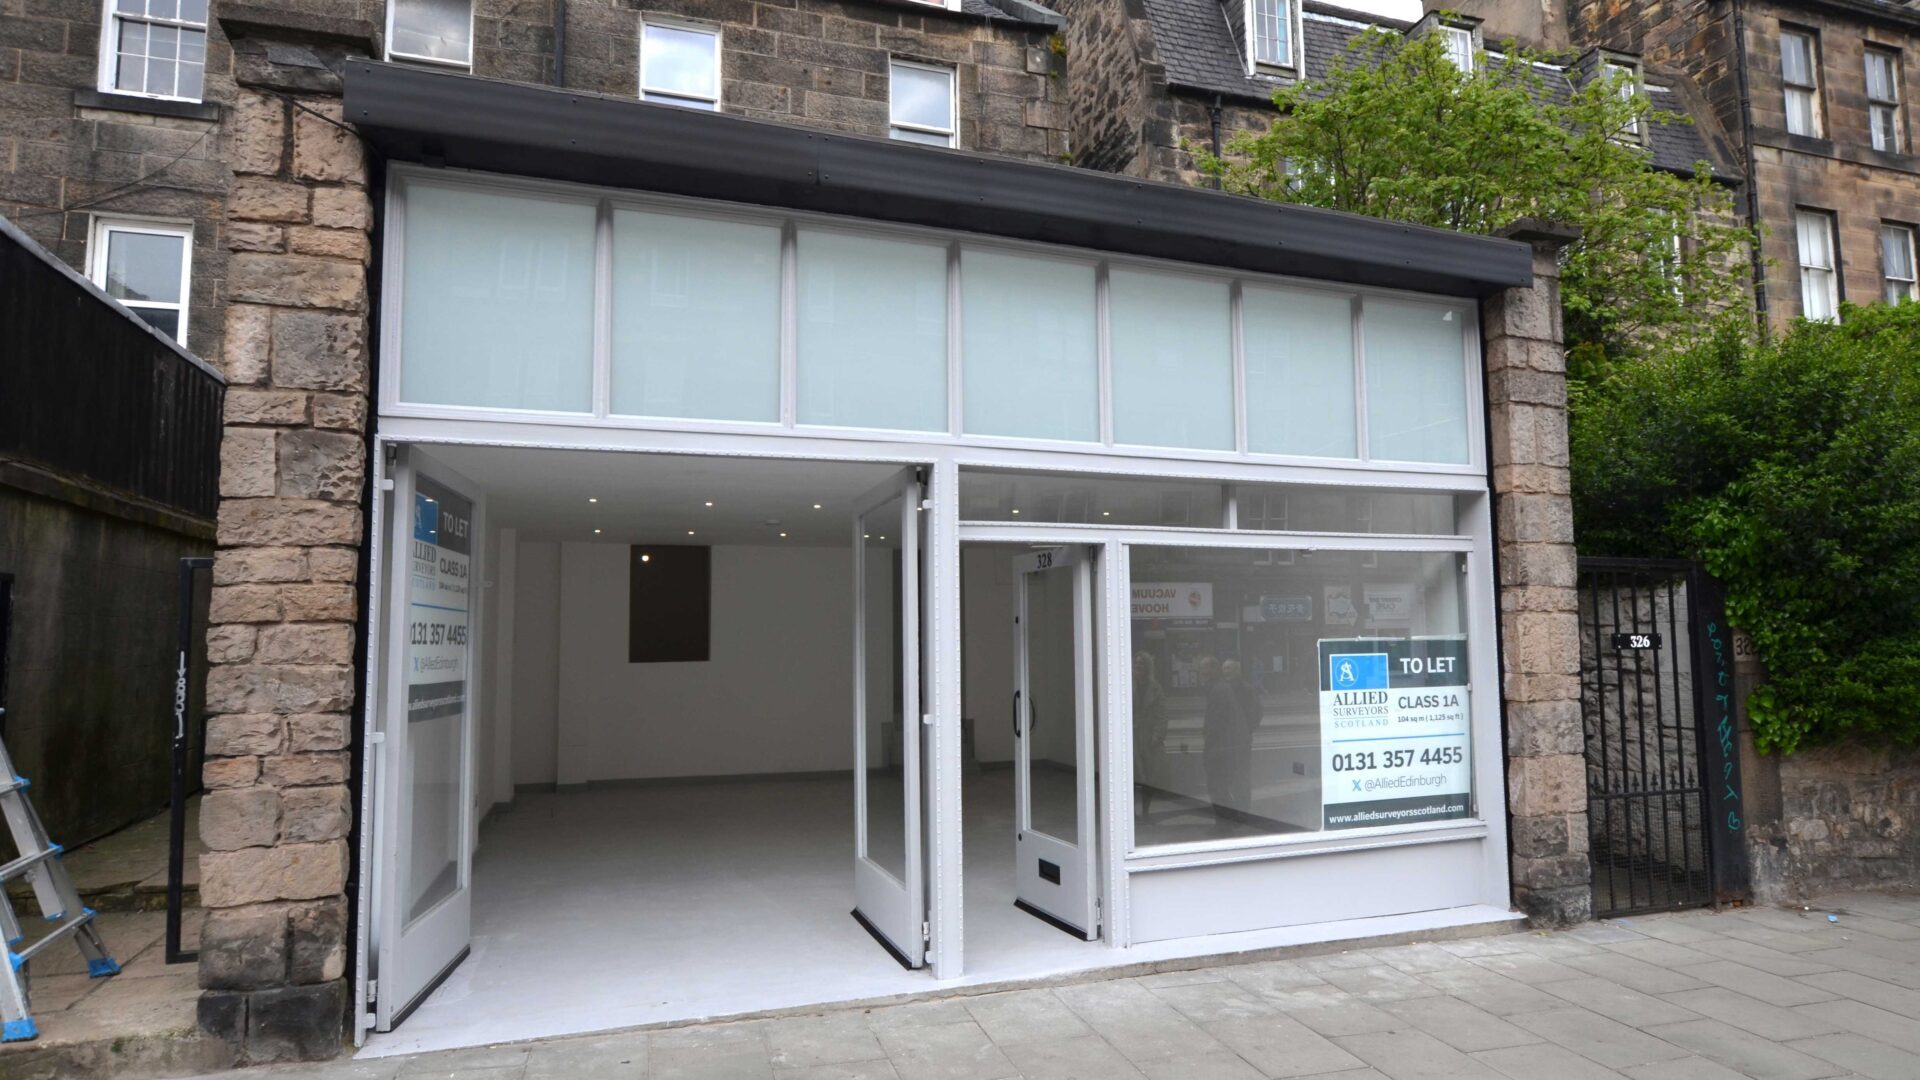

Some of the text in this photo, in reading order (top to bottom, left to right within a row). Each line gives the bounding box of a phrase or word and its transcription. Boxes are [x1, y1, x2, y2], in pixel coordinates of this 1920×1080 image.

[443, 512, 469, 537] TO LET
[413, 541, 437, 563] LLIED
[1037, 552, 1053, 569] 328
[440, 558, 467, 578] CLASS 1A
[430, 623, 445, 645] 357
[447, 624, 467, 645] 4455
[1630, 635, 1650, 648] 326
[1400, 656, 1456, 674] TO LET
[1333, 691, 1388, 706] ALLIED
[1398, 694, 1459, 709] CLASS 1A
[1333, 706, 1389, 717] SURVEYORS
[1397, 715, 1409, 723] 104
[1447, 714, 1454, 722] sq
[1334, 718, 1389, 729] SCOTLAND
[1332, 746, 1463, 772] 0131 357 4455
[1364, 773, 1447, 792] @AlliedEdinburgh
[1329, 804, 1464, 824] www.alliedsurveyorsscotland.com
